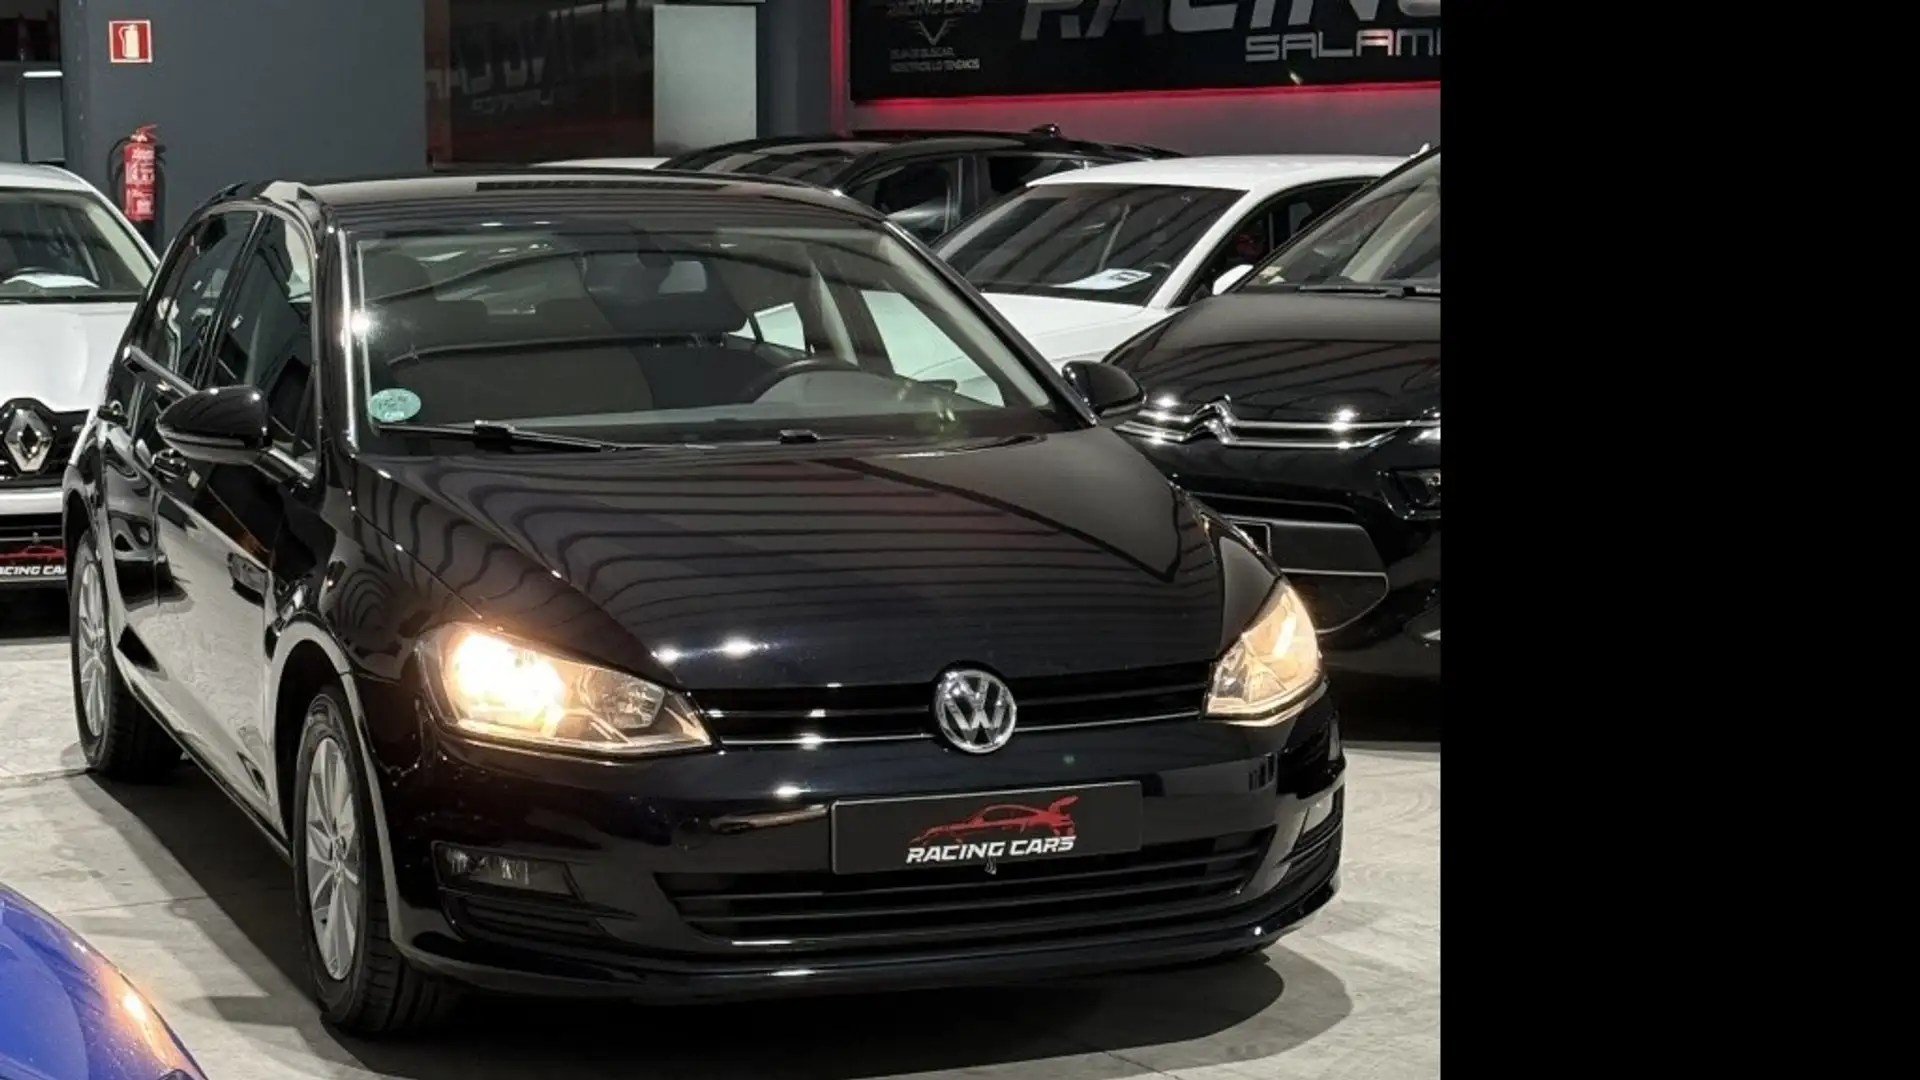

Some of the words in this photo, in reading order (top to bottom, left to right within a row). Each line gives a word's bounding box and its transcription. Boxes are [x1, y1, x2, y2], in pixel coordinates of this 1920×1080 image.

[1244, 27, 1441, 62] SALAM
[906, 842, 1006, 864] RACING
[1009, 835, 1076, 856] CARS
